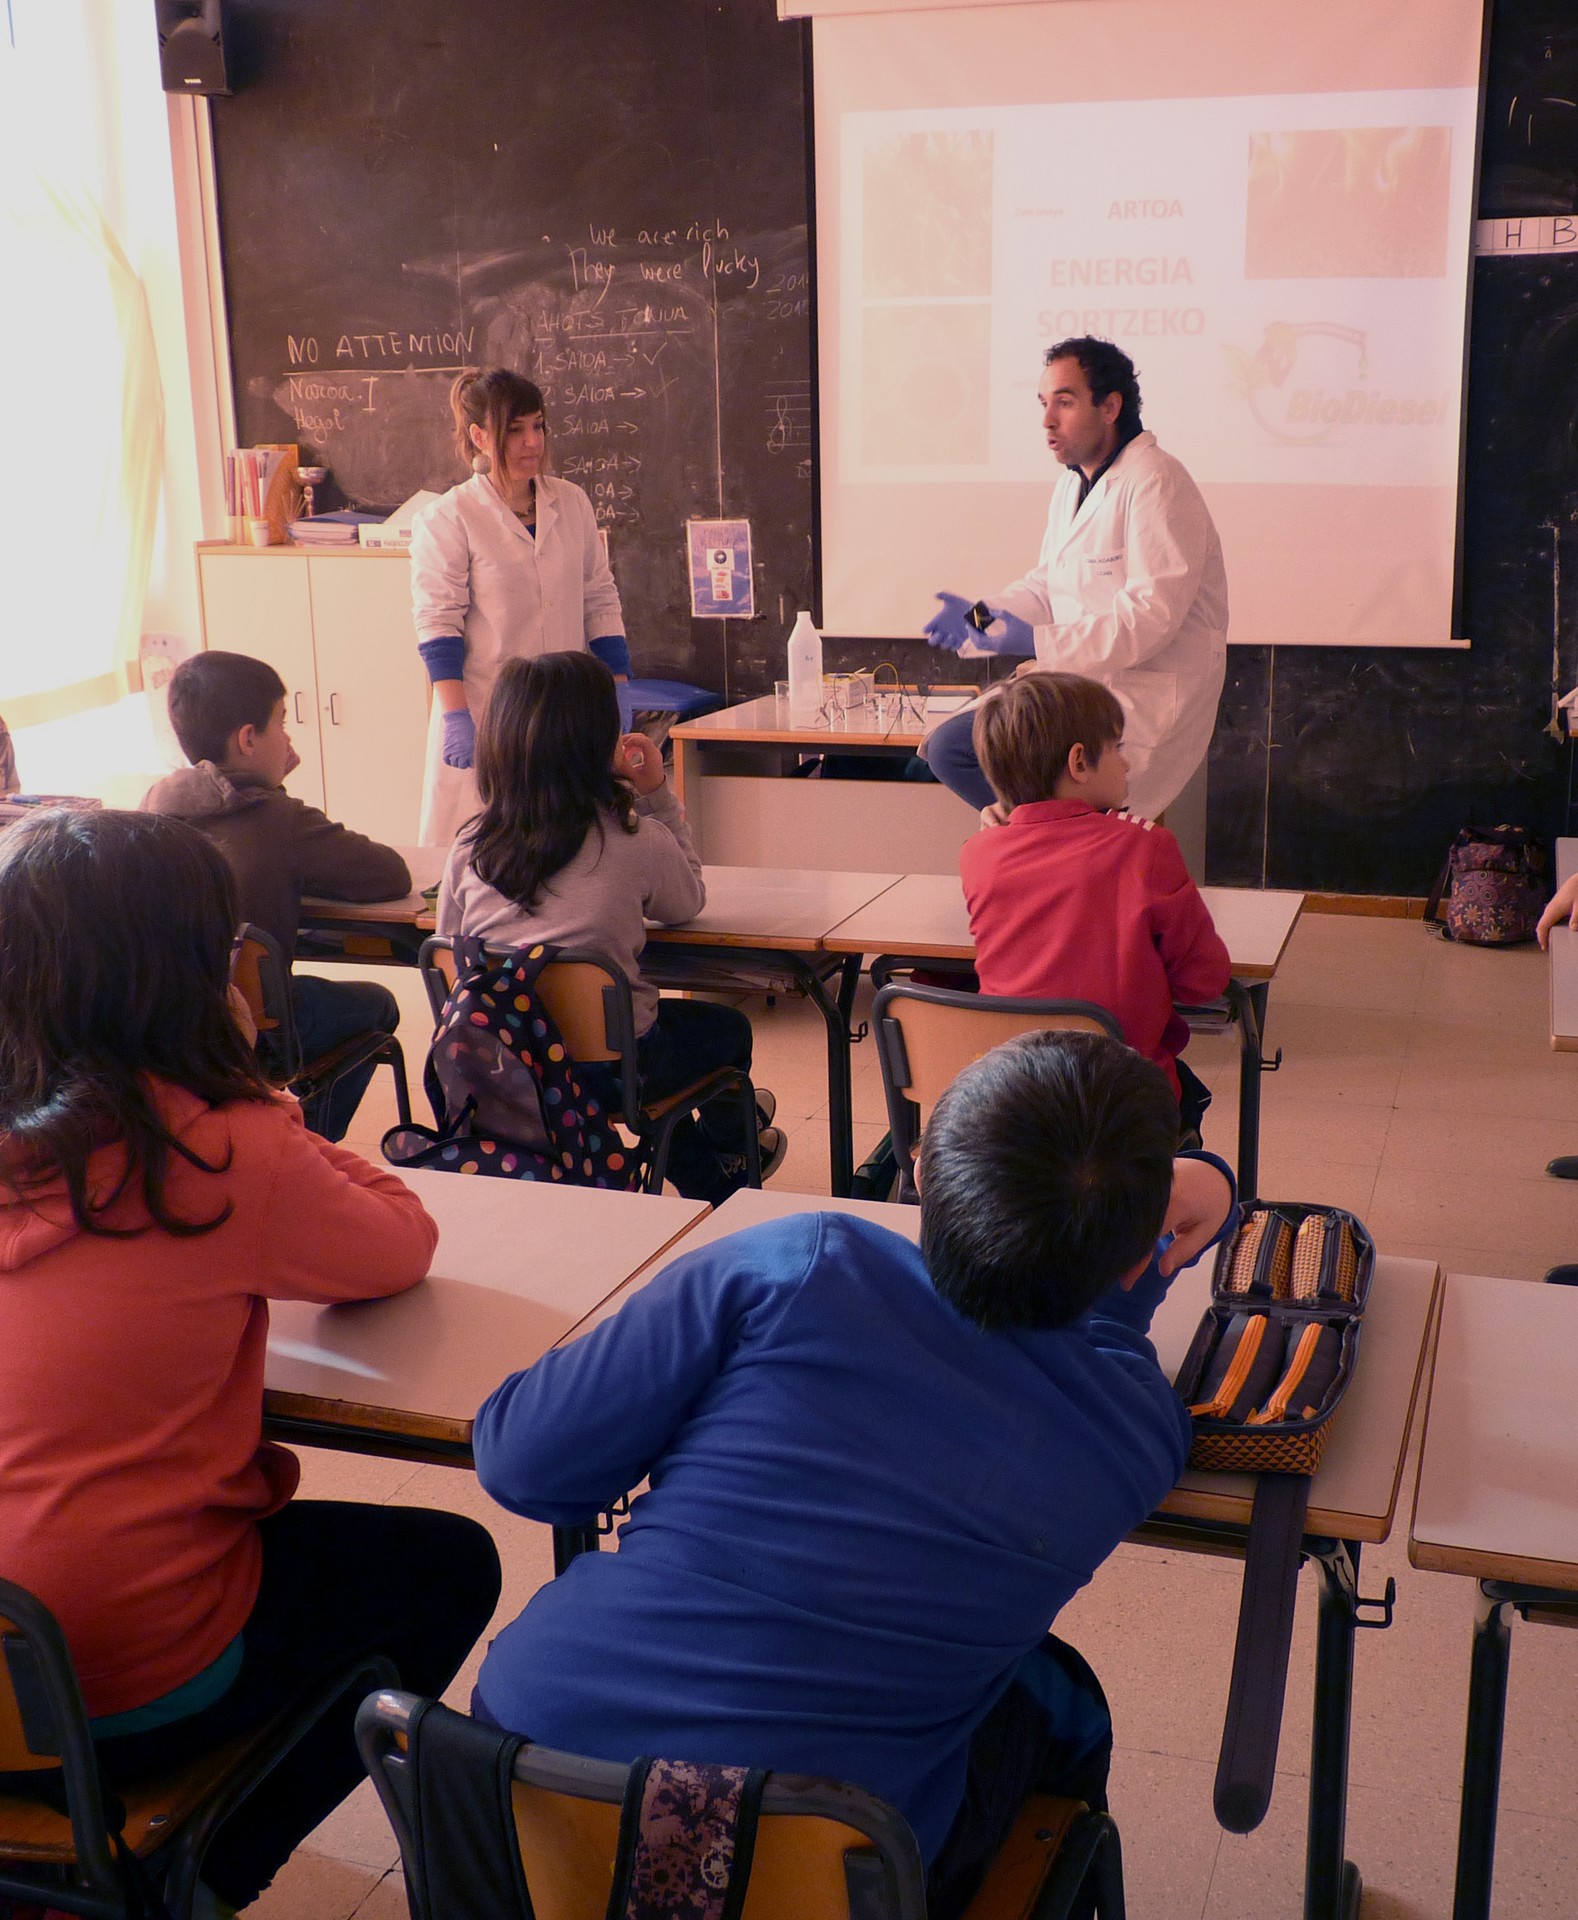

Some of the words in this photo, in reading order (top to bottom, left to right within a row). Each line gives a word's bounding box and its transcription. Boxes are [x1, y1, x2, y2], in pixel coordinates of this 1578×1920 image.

[1107, 199, 1184, 220] ARTOA
[686, 217, 729, 242] rich
[1505, 219, 1522, 248] H
[1553, 217, 1577, 246] B
[565, 243, 615, 311] They
[640, 261, 682, 283] were
[702, 242, 760, 289] lucky
[766, 273, 809, 293] 201
[1050, 256, 1193, 287] ENERGIA
[1036, 307, 1206, 338] SORTZEKO
[287, 334, 319, 364] NO
[335, 326, 475, 358] ATTENTION
[1285, 388, 1451, 426] BioDiesel
